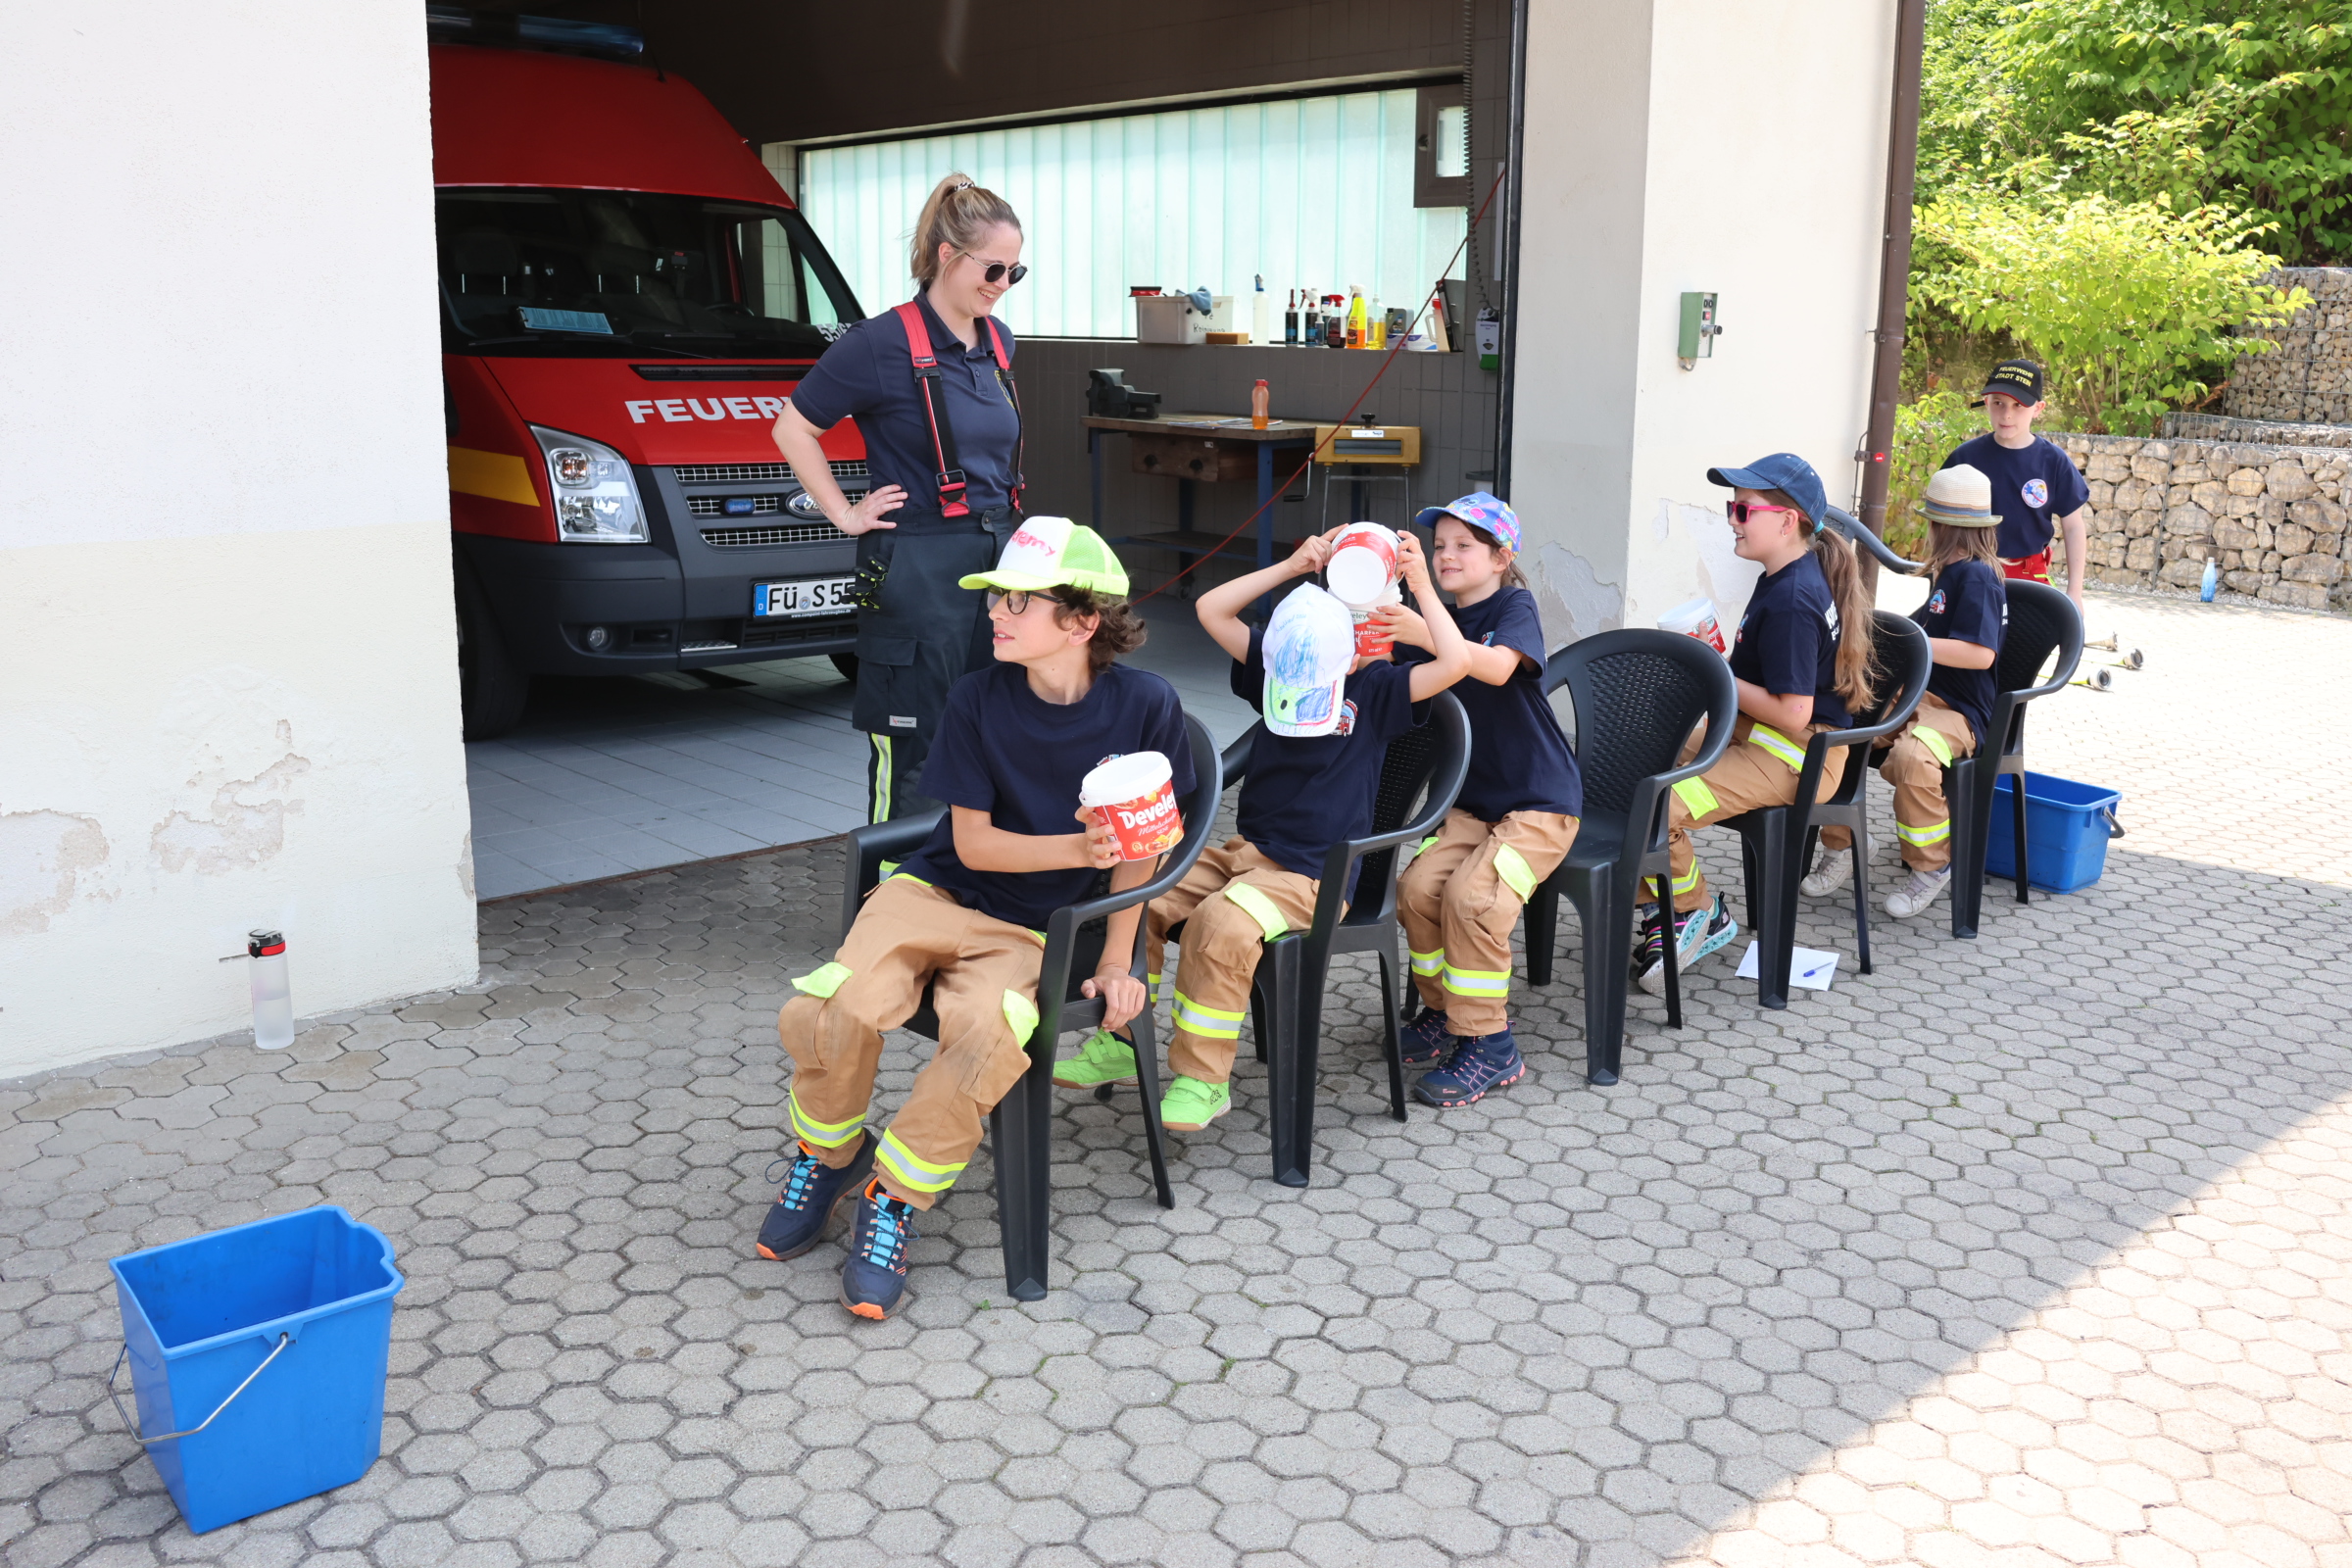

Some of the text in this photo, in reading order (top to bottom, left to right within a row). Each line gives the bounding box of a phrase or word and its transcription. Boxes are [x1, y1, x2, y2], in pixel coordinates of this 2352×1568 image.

[1999, 366, 2034, 379] FEUERWEHR
[2015, 374, 2033, 387] STEIN
[624, 396, 793, 423] FEUER
[768, 586, 798, 612] Fü
[812, 584, 825, 607] S
